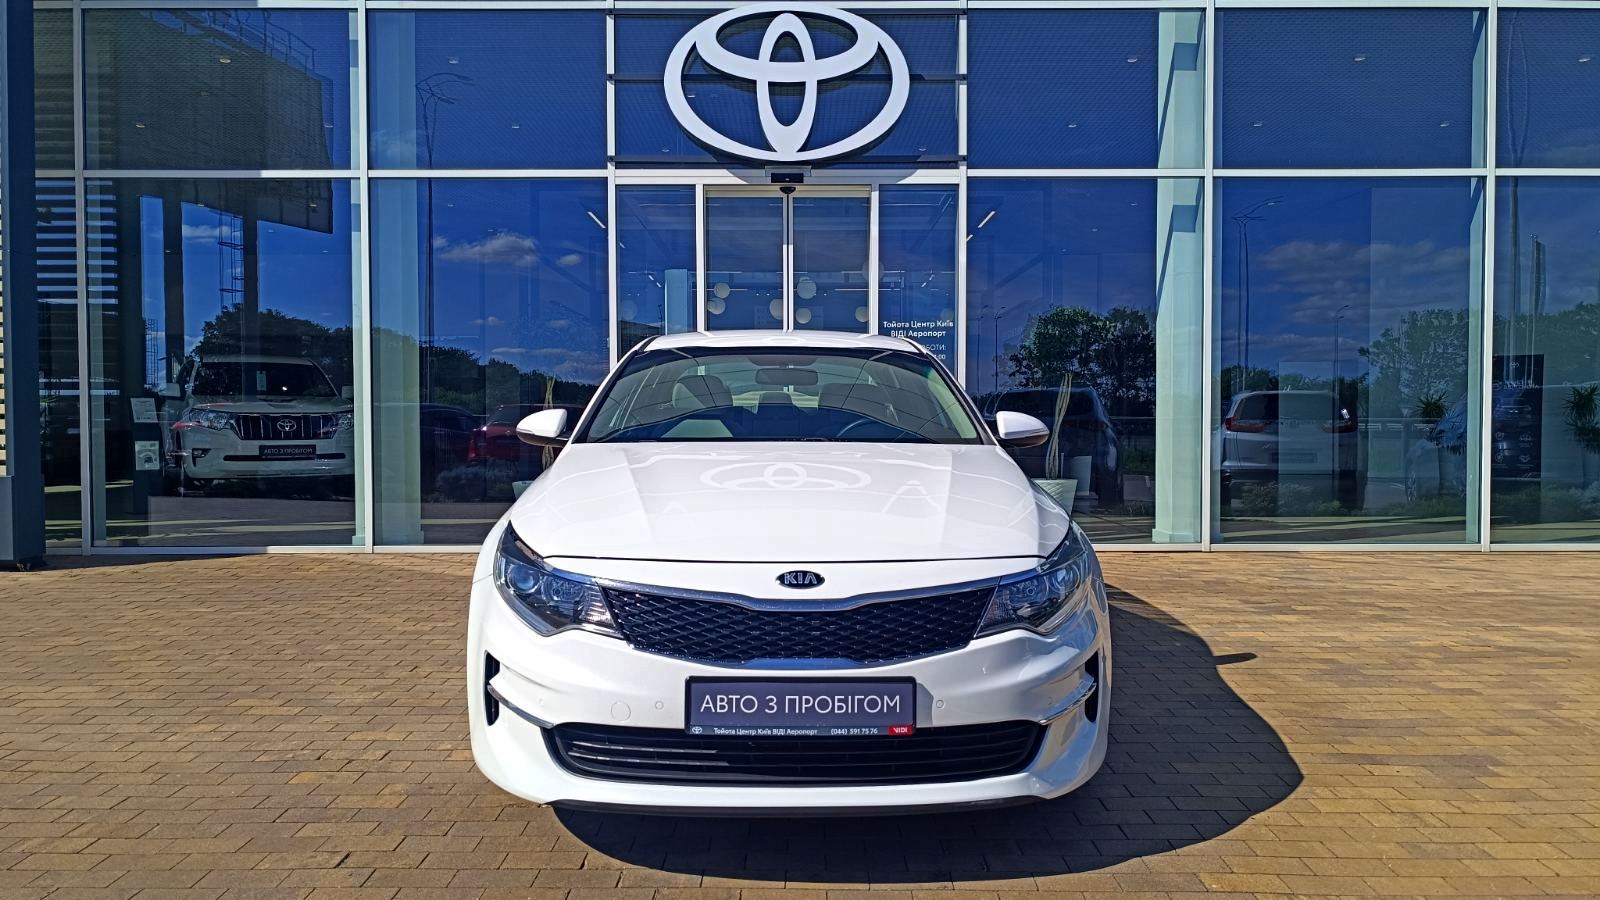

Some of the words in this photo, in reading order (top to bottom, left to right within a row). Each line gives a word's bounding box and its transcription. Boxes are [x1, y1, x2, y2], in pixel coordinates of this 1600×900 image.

[883, 320, 909, 328] Тойота
[910, 320, 936, 329] Центр
[936, 319, 954, 327] Київ
[890, 330, 907, 338] ВІДІ
[907, 330, 946, 338] Аеропорт
[784, 572, 818, 585] KIA
[700, 695, 759, 713] АВТО
[764, 695, 777, 713] З
[785, 695, 900, 713] ПРОБІГОМ
[736, 728, 757, 736] Центр
[786, 728, 818, 736] Аеропорт
